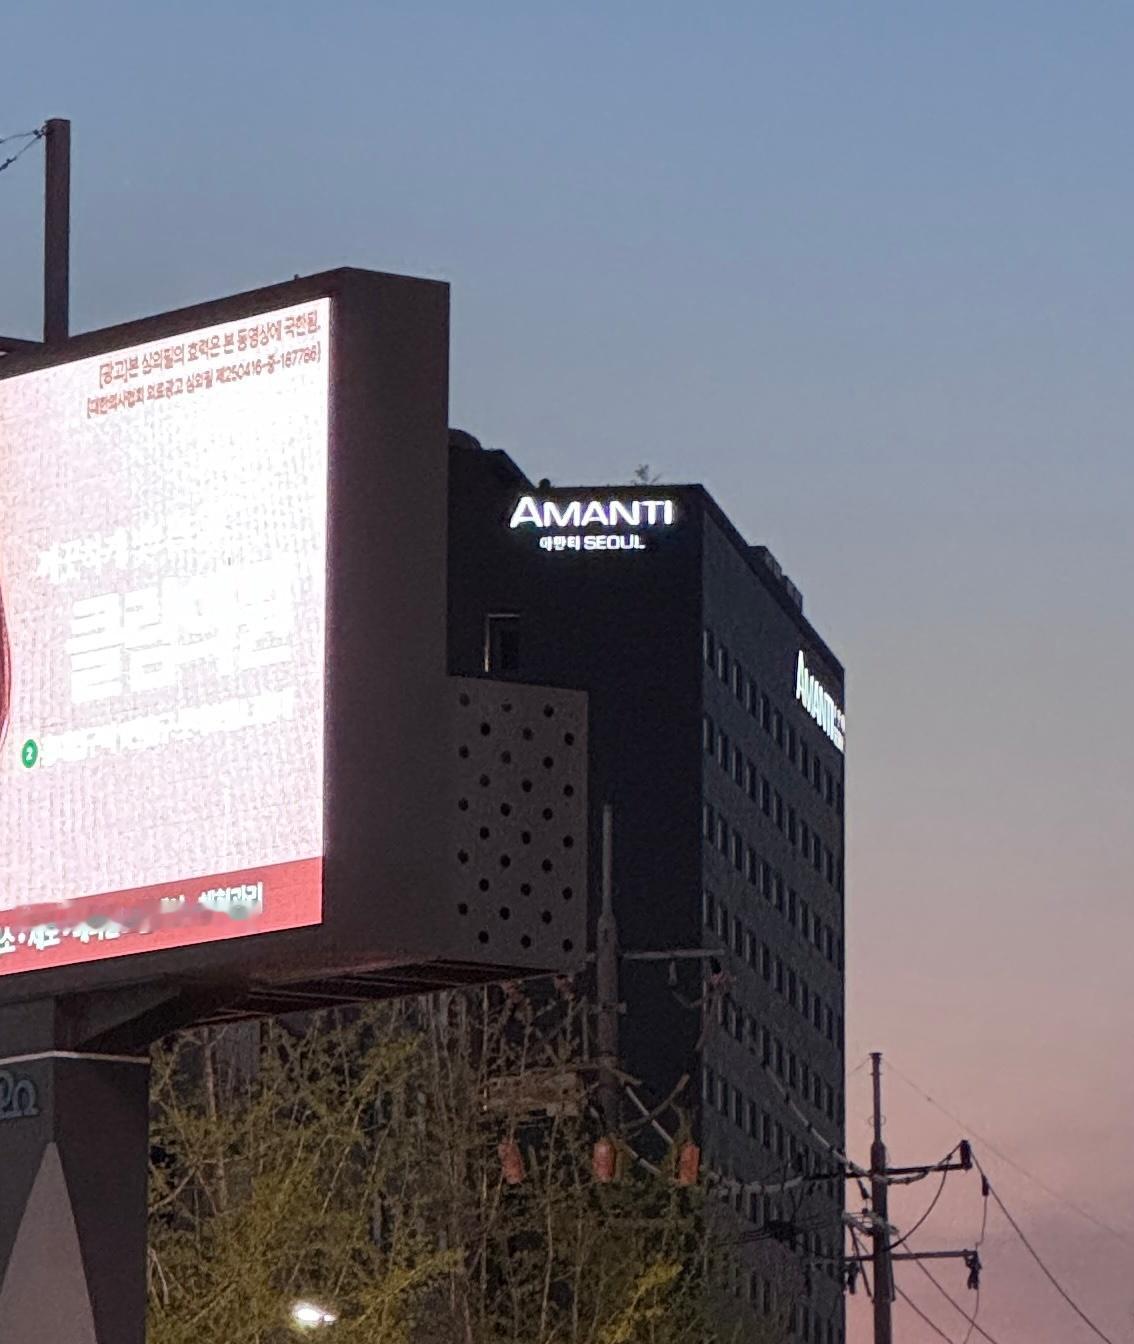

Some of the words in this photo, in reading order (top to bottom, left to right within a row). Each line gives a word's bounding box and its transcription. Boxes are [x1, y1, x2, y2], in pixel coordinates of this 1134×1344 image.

[188, 335, 220, 362] 효력은
[224, 332, 235, 354] 본
[238, 320, 282, 352] 동영상에
[510, 496, 673, 528] AMANTI
[584, 534, 646, 550] SEOUL
